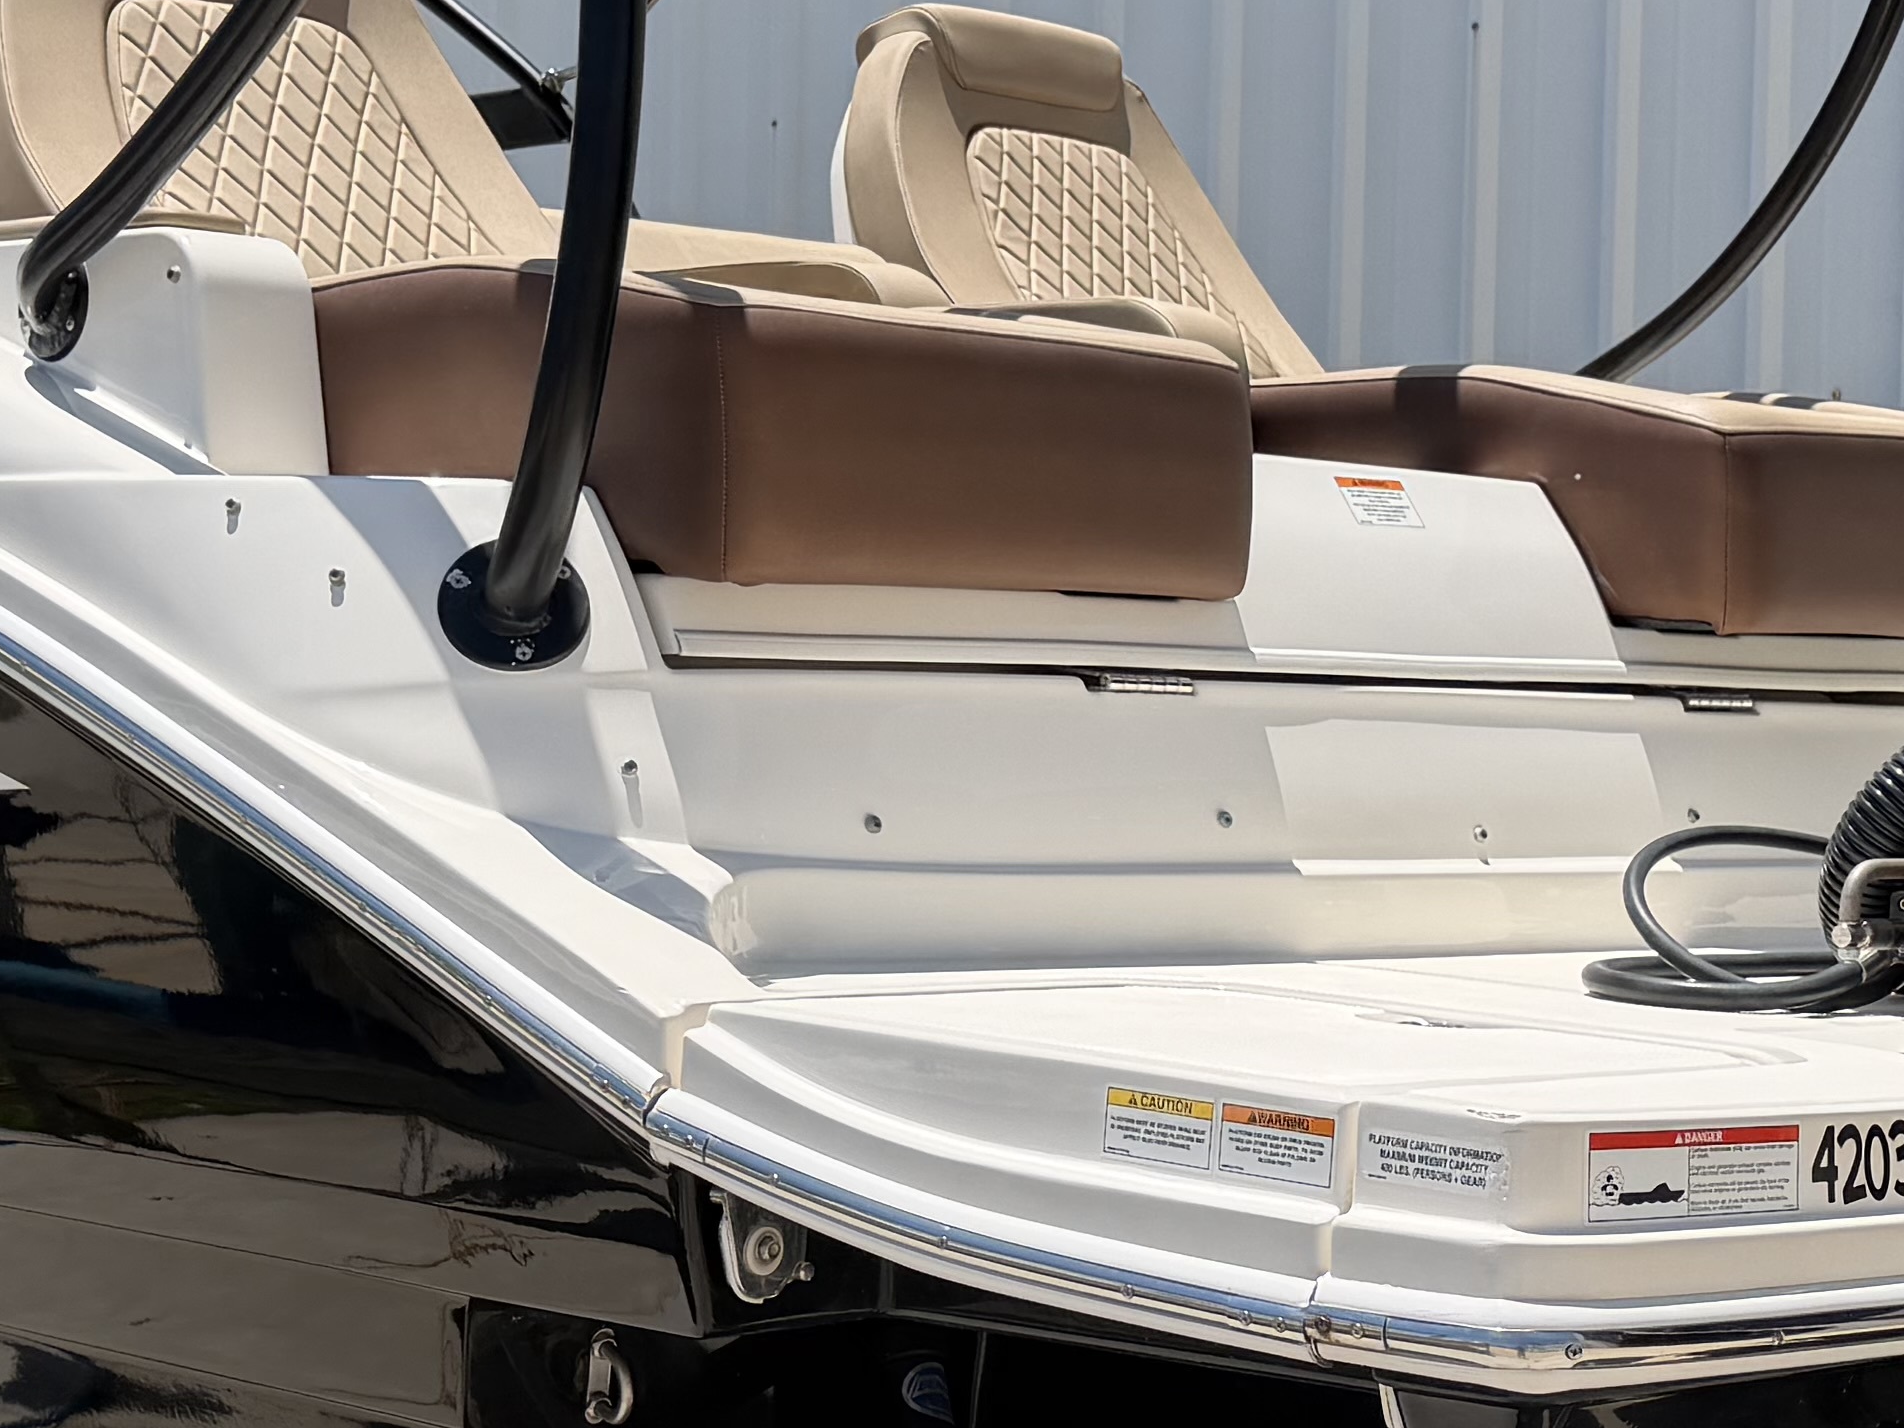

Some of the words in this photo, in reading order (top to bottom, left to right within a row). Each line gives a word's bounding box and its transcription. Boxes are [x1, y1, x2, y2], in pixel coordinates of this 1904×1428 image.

[1140, 1095, 1193, 1114] CAUTION
[1258, 1111, 1310, 1131] WARNING
[1369, 1133, 1408, 1149] PLATFORM
[1410, 1140, 1447, 1155] CAPACITY
[1684, 1131, 1723, 1143] DANGER
[1380, 1148, 1416, 1163] MAXIMUM
[1418, 1155, 1448, 1169] WEIGHT
[1449, 1159, 1489, 1174] CAPACITY
